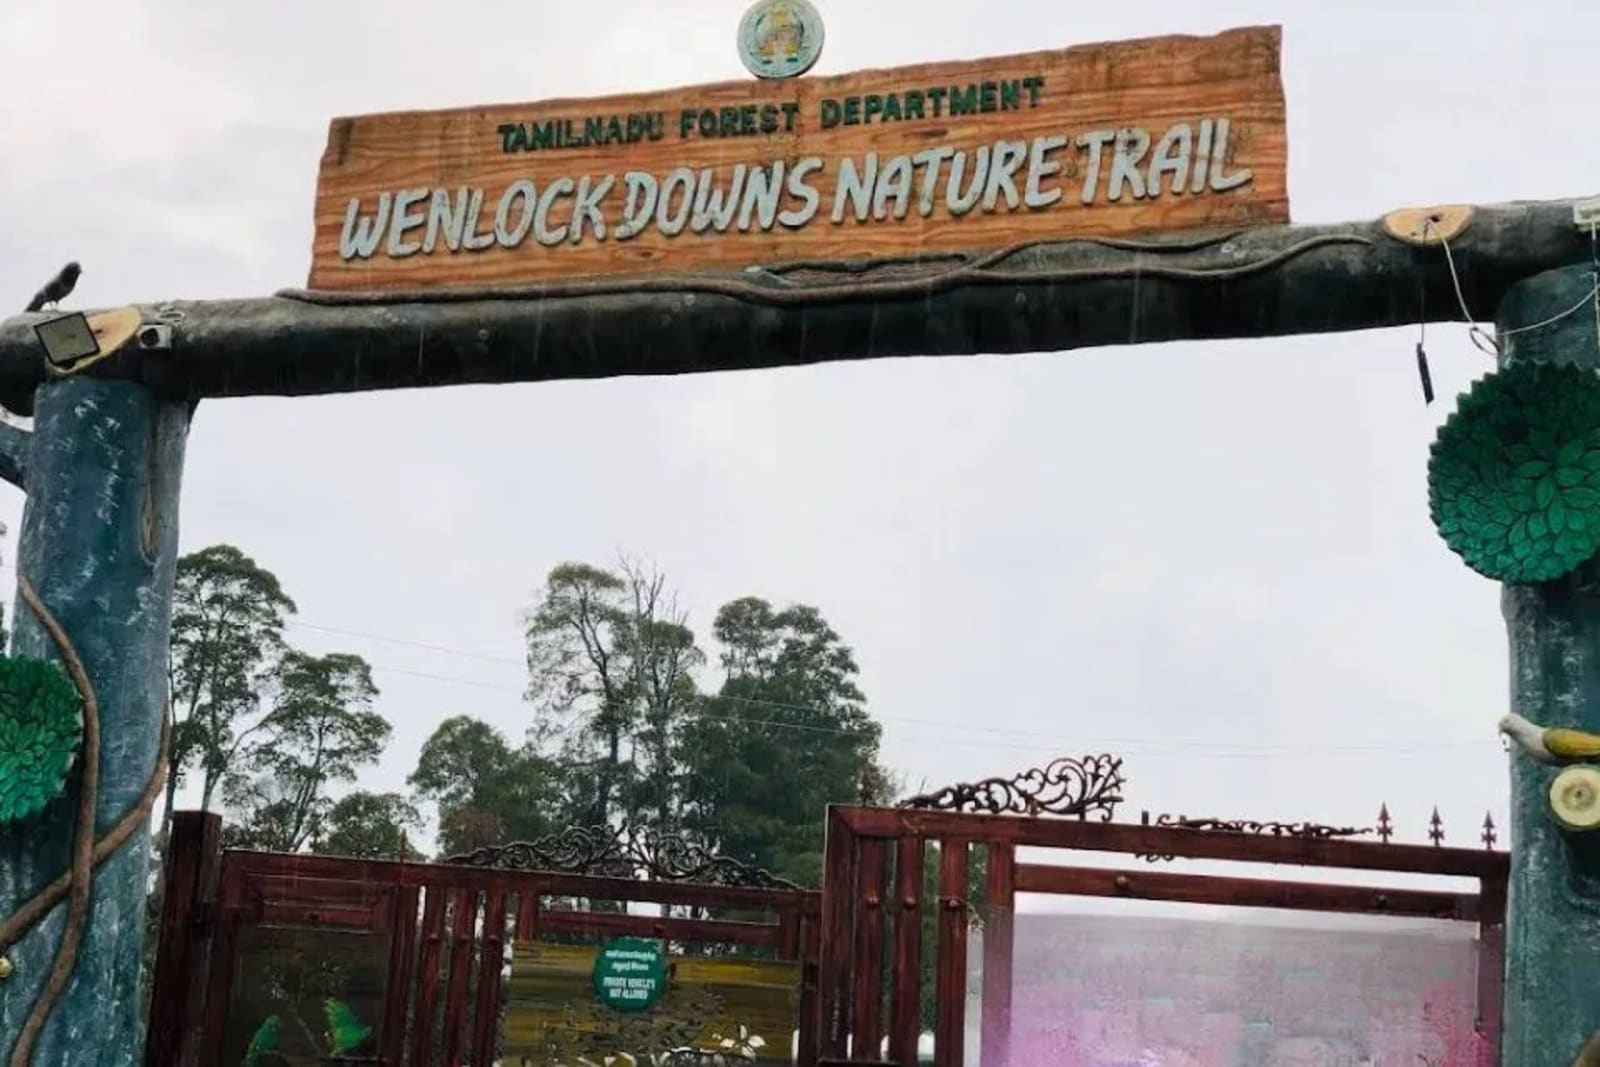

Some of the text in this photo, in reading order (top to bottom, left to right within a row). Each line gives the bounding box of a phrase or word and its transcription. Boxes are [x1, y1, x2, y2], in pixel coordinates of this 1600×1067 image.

[497, 75, 1045, 154] TAMILNADU FOREST DEPARTMENT
[339, 117, 1253, 262] WENLOCK DOWNS NATURE TRAIL
